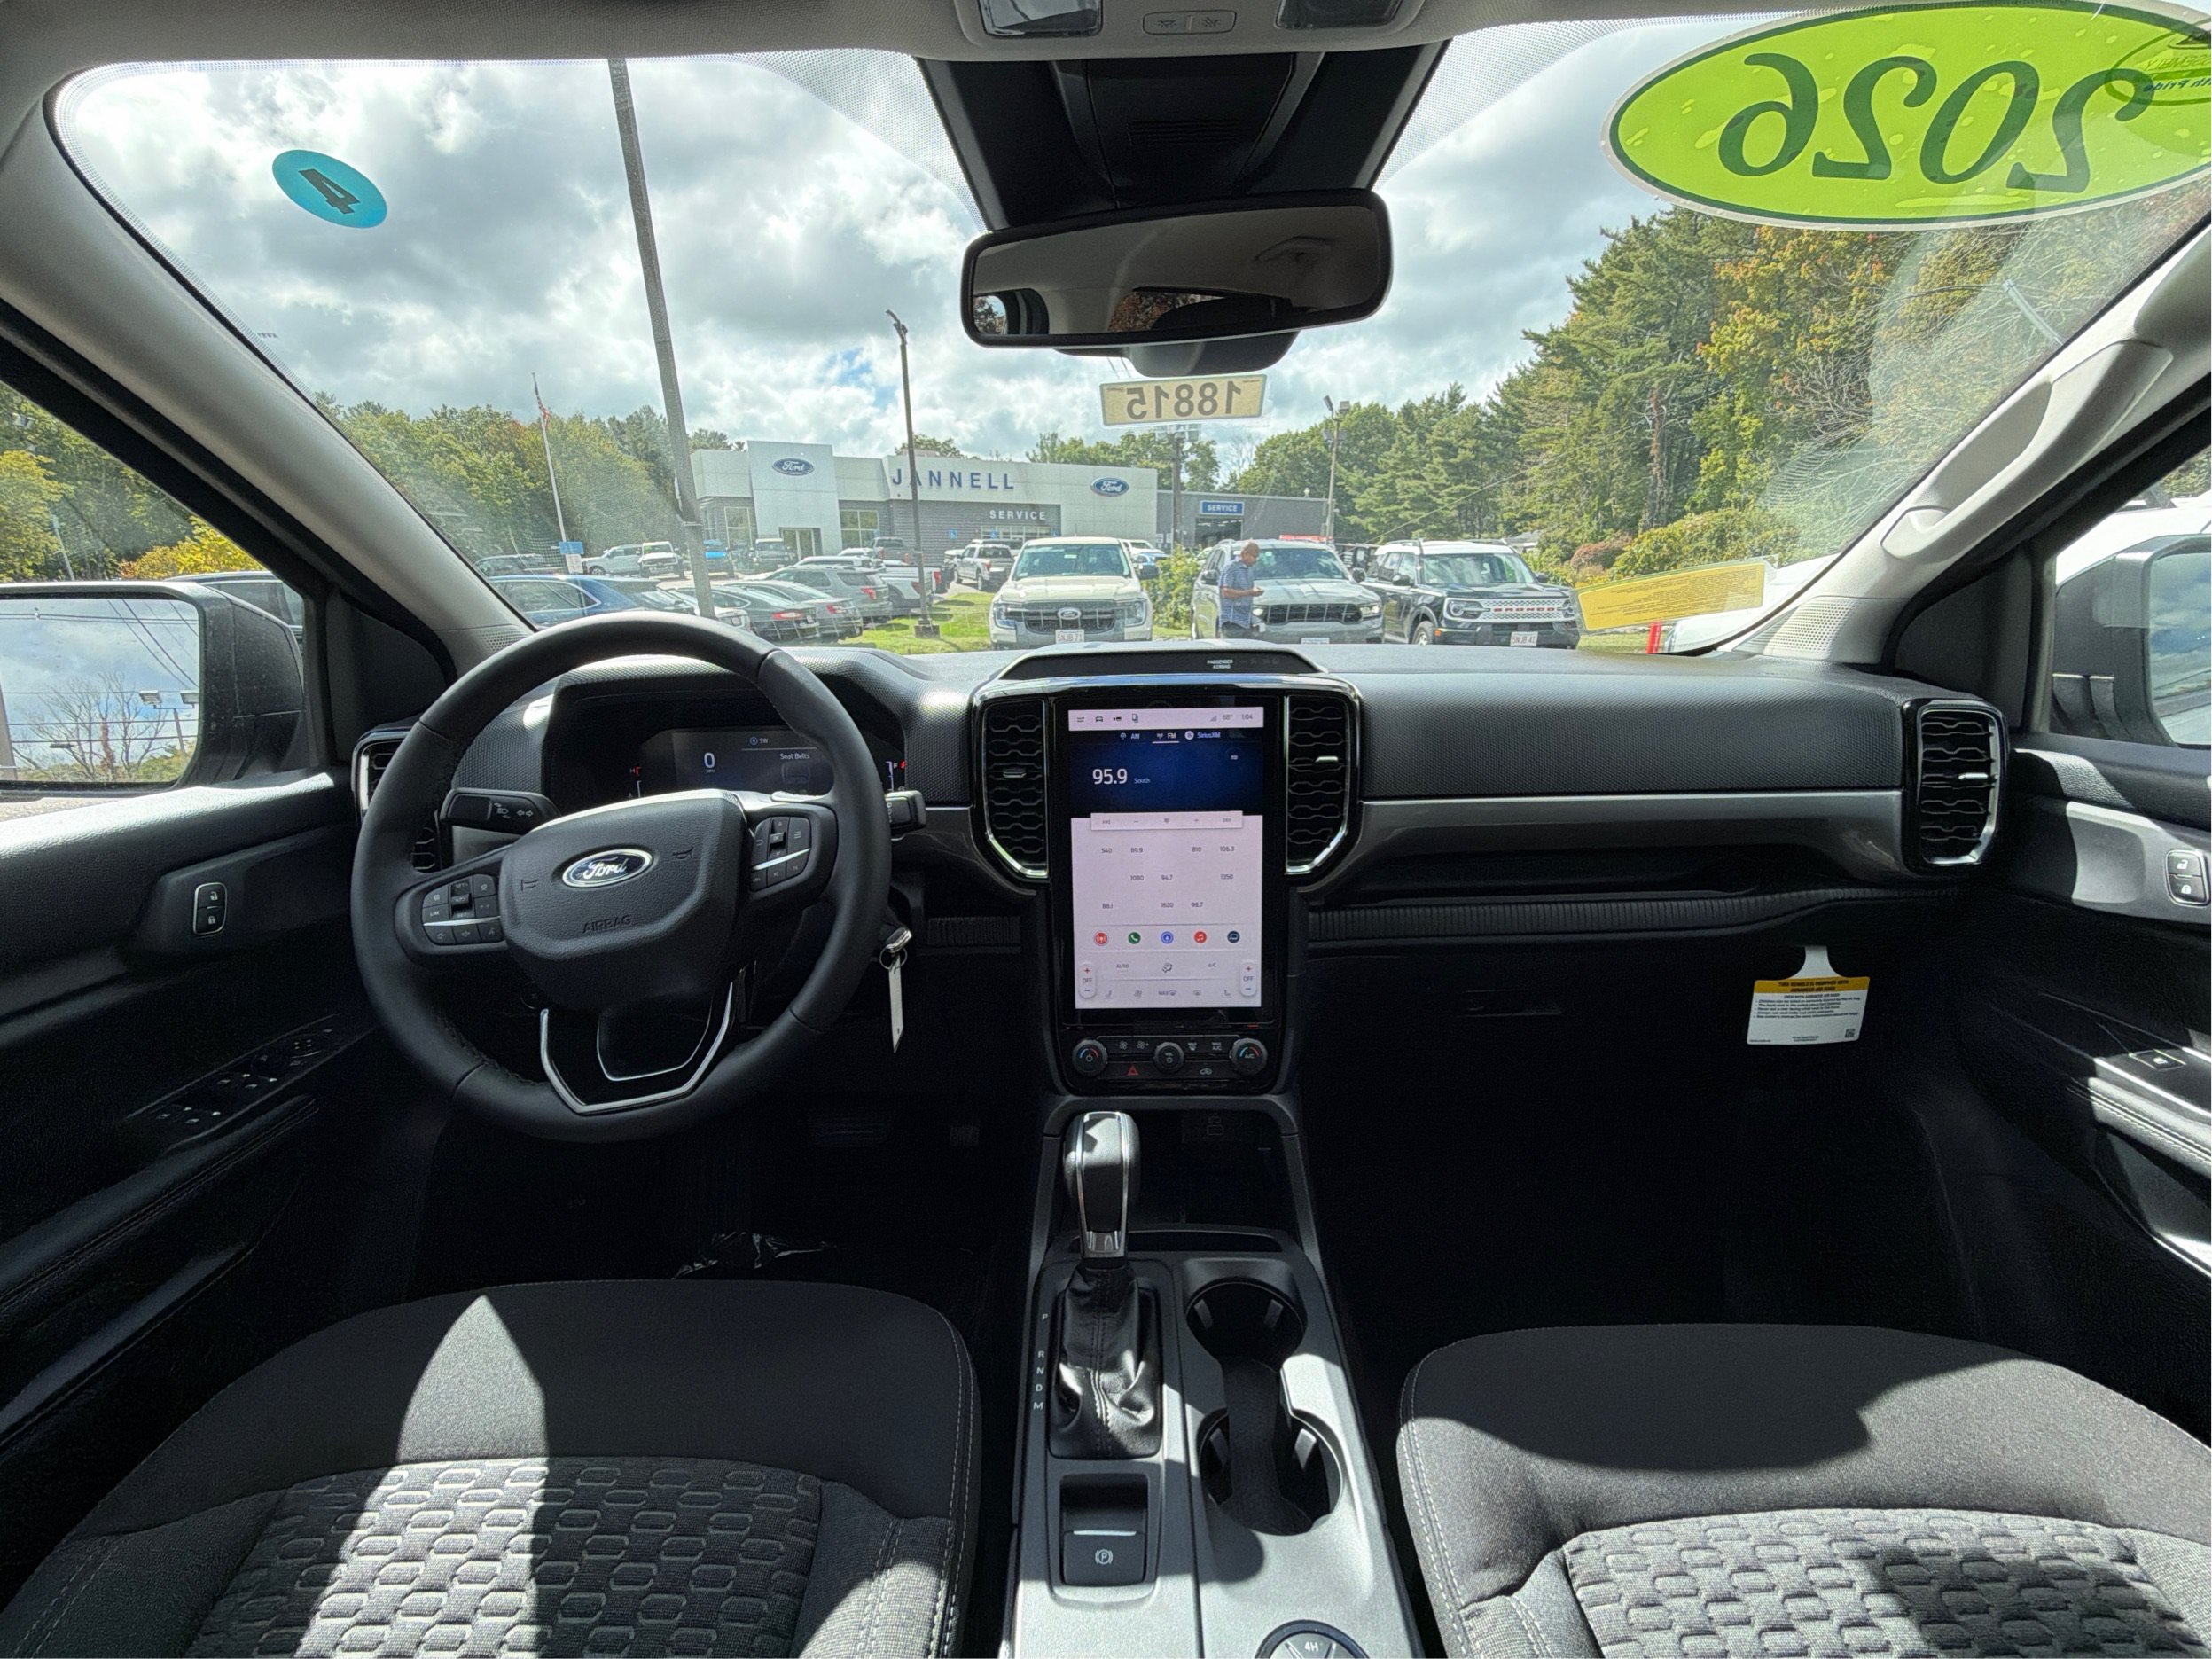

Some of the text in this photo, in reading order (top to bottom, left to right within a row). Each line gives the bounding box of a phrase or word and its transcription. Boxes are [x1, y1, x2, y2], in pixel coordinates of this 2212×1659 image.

[989, 509, 1046, 520] SERVICE
[1207, 504, 1238, 513] SERVICE
[704, 752, 715, 768] 0
[1092, 768, 1128, 785] 95.9
[582, 855, 629, 880] Ford
[582, 914, 633, 935] AIRBAG
[1304, 1641, 1319, 1652] 4H
